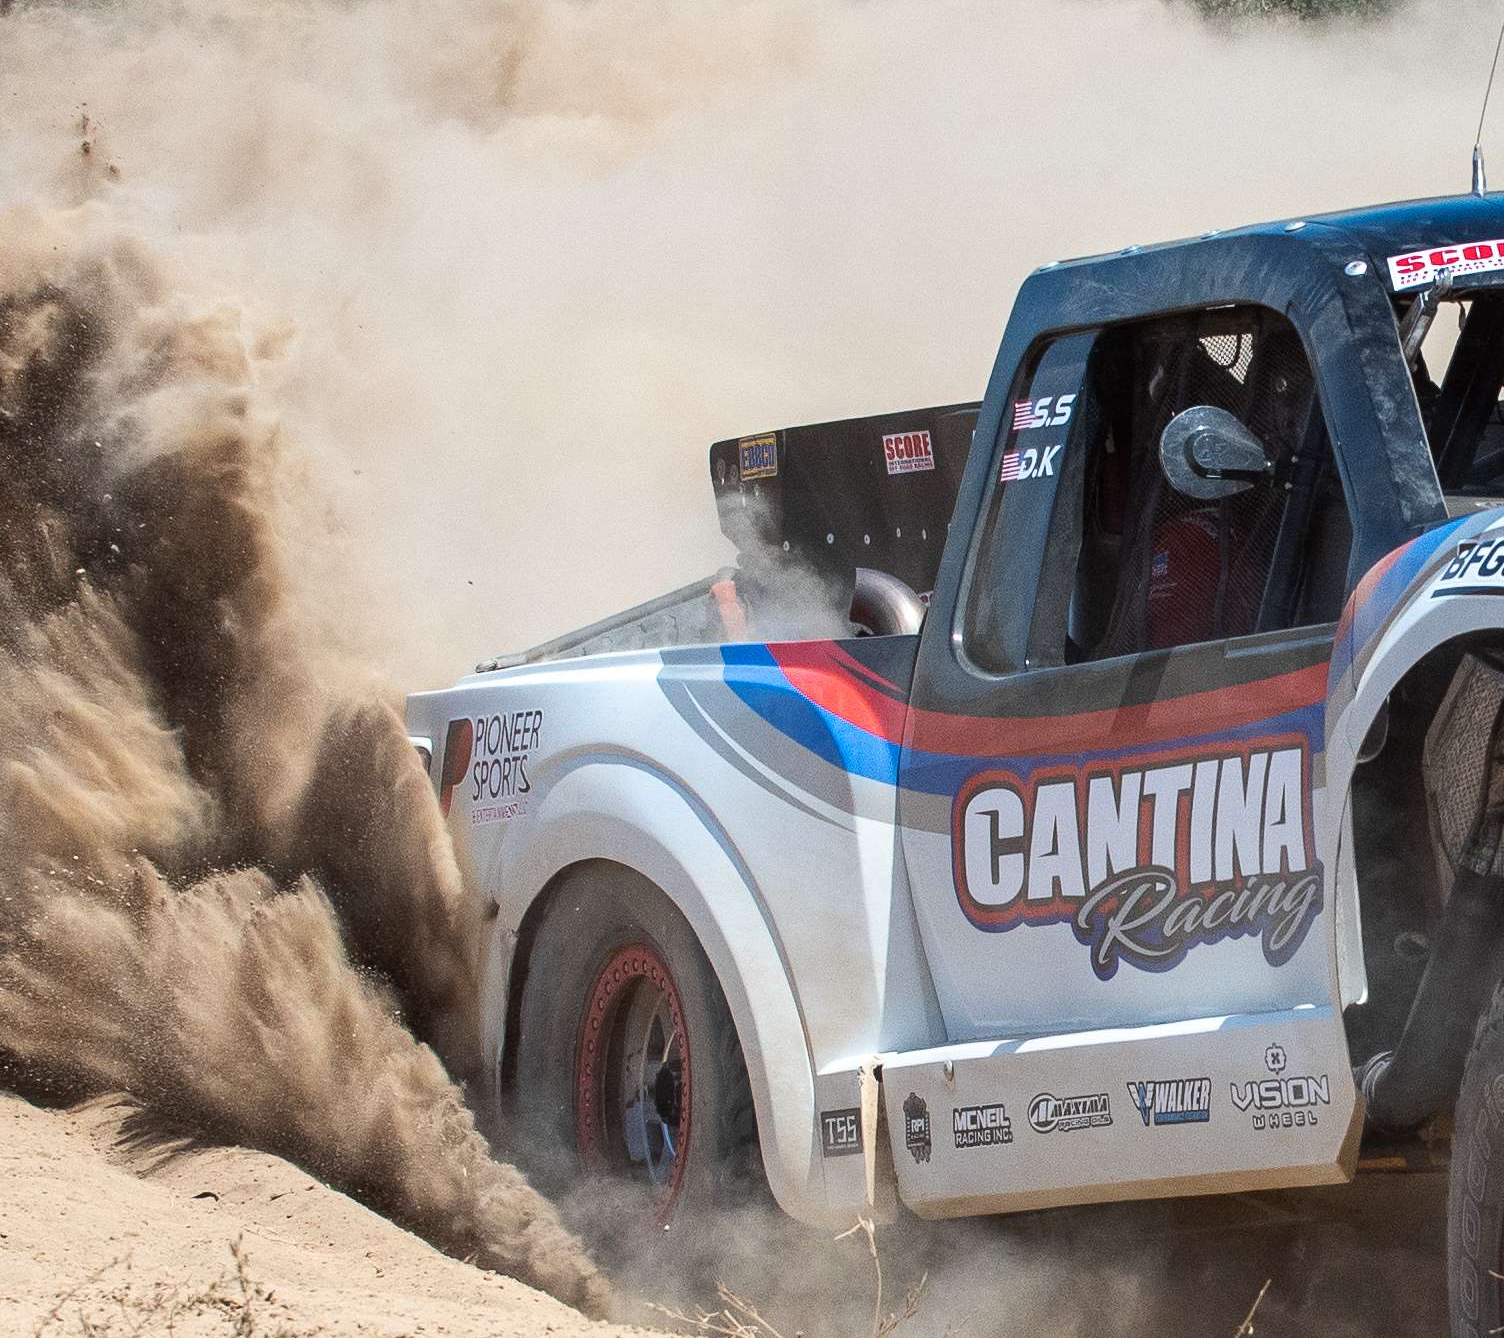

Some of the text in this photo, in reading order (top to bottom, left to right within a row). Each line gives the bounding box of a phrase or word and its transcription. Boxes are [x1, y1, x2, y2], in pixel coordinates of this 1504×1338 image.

[885, 433, 931, 461] SCORE
[475, 710, 543, 758] PIONEER
[473, 755, 531, 801] SPORTS
[963, 748, 1309, 906] CANTINA
[1077, 870, 1320, 964] Racing
[1156, 1079, 1210, 1113] WALKER
[1231, 1074, 1330, 1112] VISION
[954, 1107, 1011, 1132] MCNEIL
[956, 1130, 992, 1145] RACING
[1252, 1110, 1318, 1131] WHEEL
